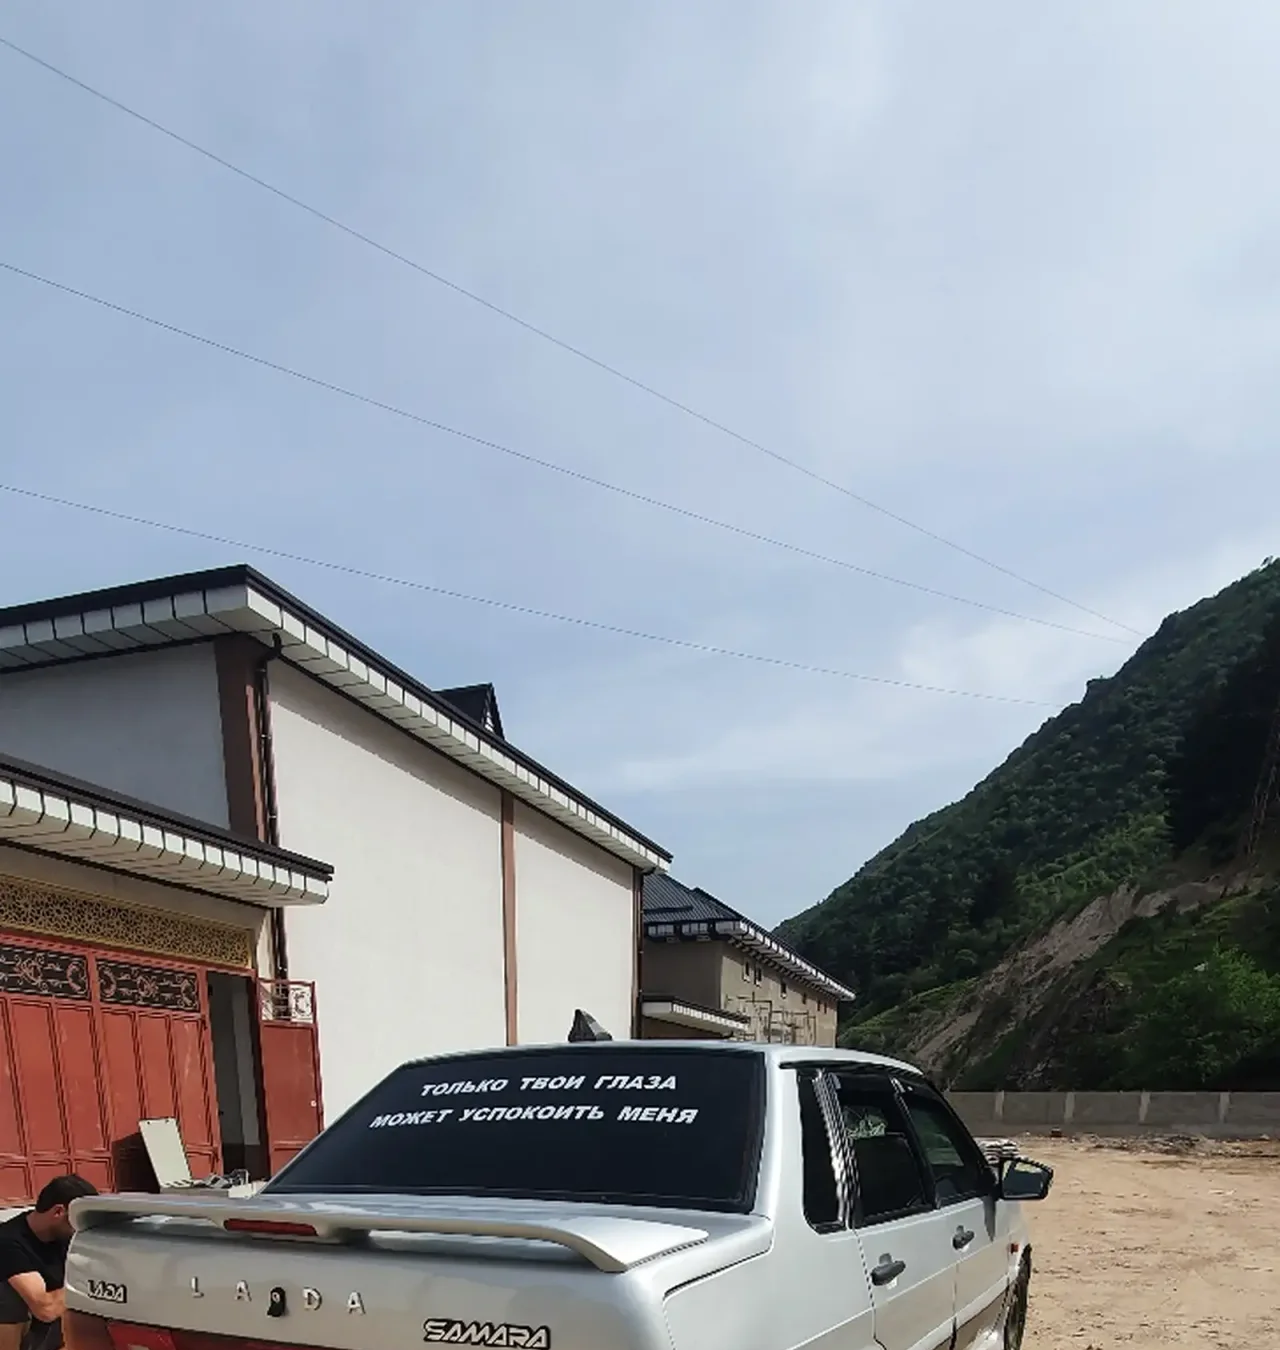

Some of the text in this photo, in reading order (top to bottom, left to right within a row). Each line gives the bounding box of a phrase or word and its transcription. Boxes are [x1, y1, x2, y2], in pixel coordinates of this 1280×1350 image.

[420, 1075, 677, 1097] ТОЛЬКО ТВОИ ГЛАЗА
[369, 1105, 699, 1128] МОЖЕТ УСПОКОИТЬ МЕНЯ
[424, 1319, 550, 1350] SAMARA
